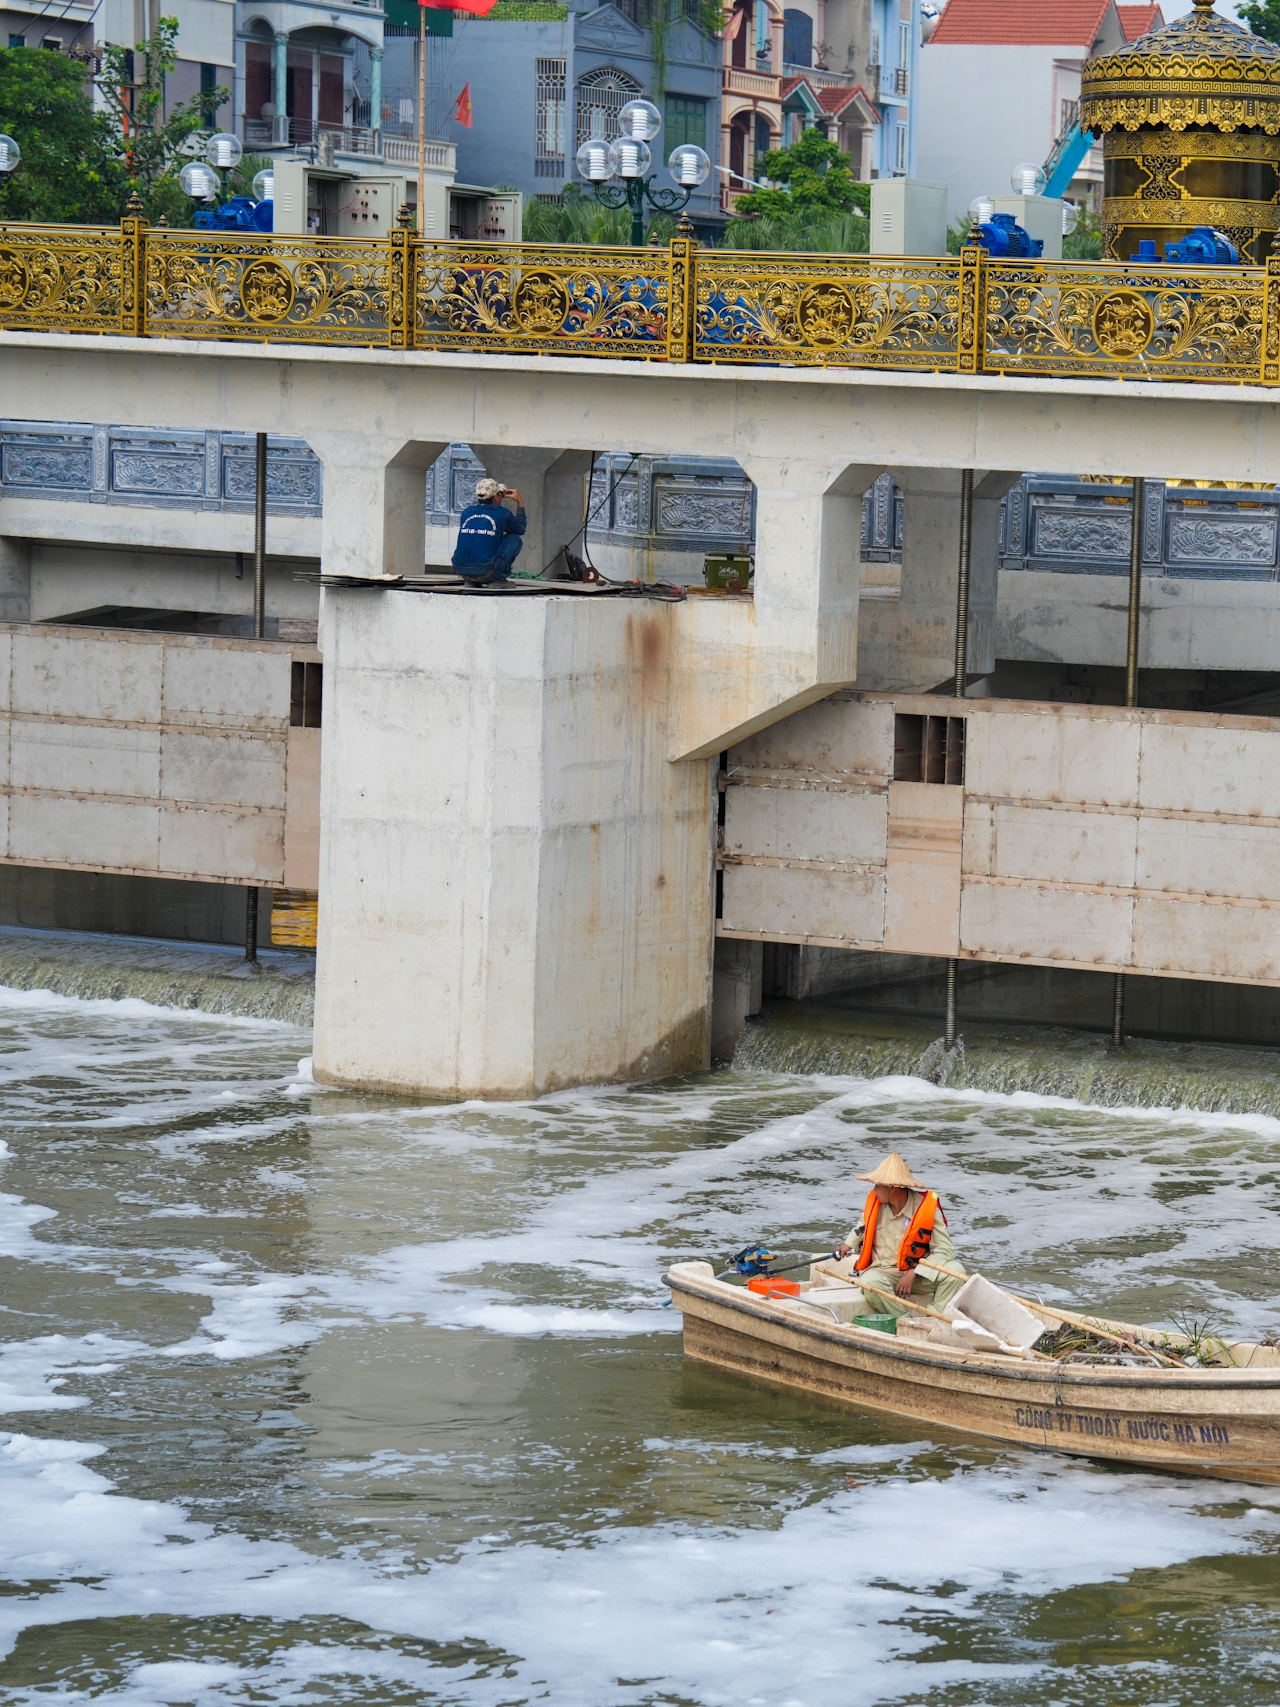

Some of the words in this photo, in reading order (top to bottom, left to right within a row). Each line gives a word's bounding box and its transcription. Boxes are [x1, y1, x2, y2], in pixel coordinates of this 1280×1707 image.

[1015, 1405, 1053, 1431] CÔNG
[1057, 1412, 1072, 1432] TY
[1076, 1413, 1121, 1437] THOÁT
[1126, 1417, 1170, 1442] NƯỚC
[1172, 1419, 1196, 1443] HÀ
[1199, 1422, 1230, 1447] NỘI
